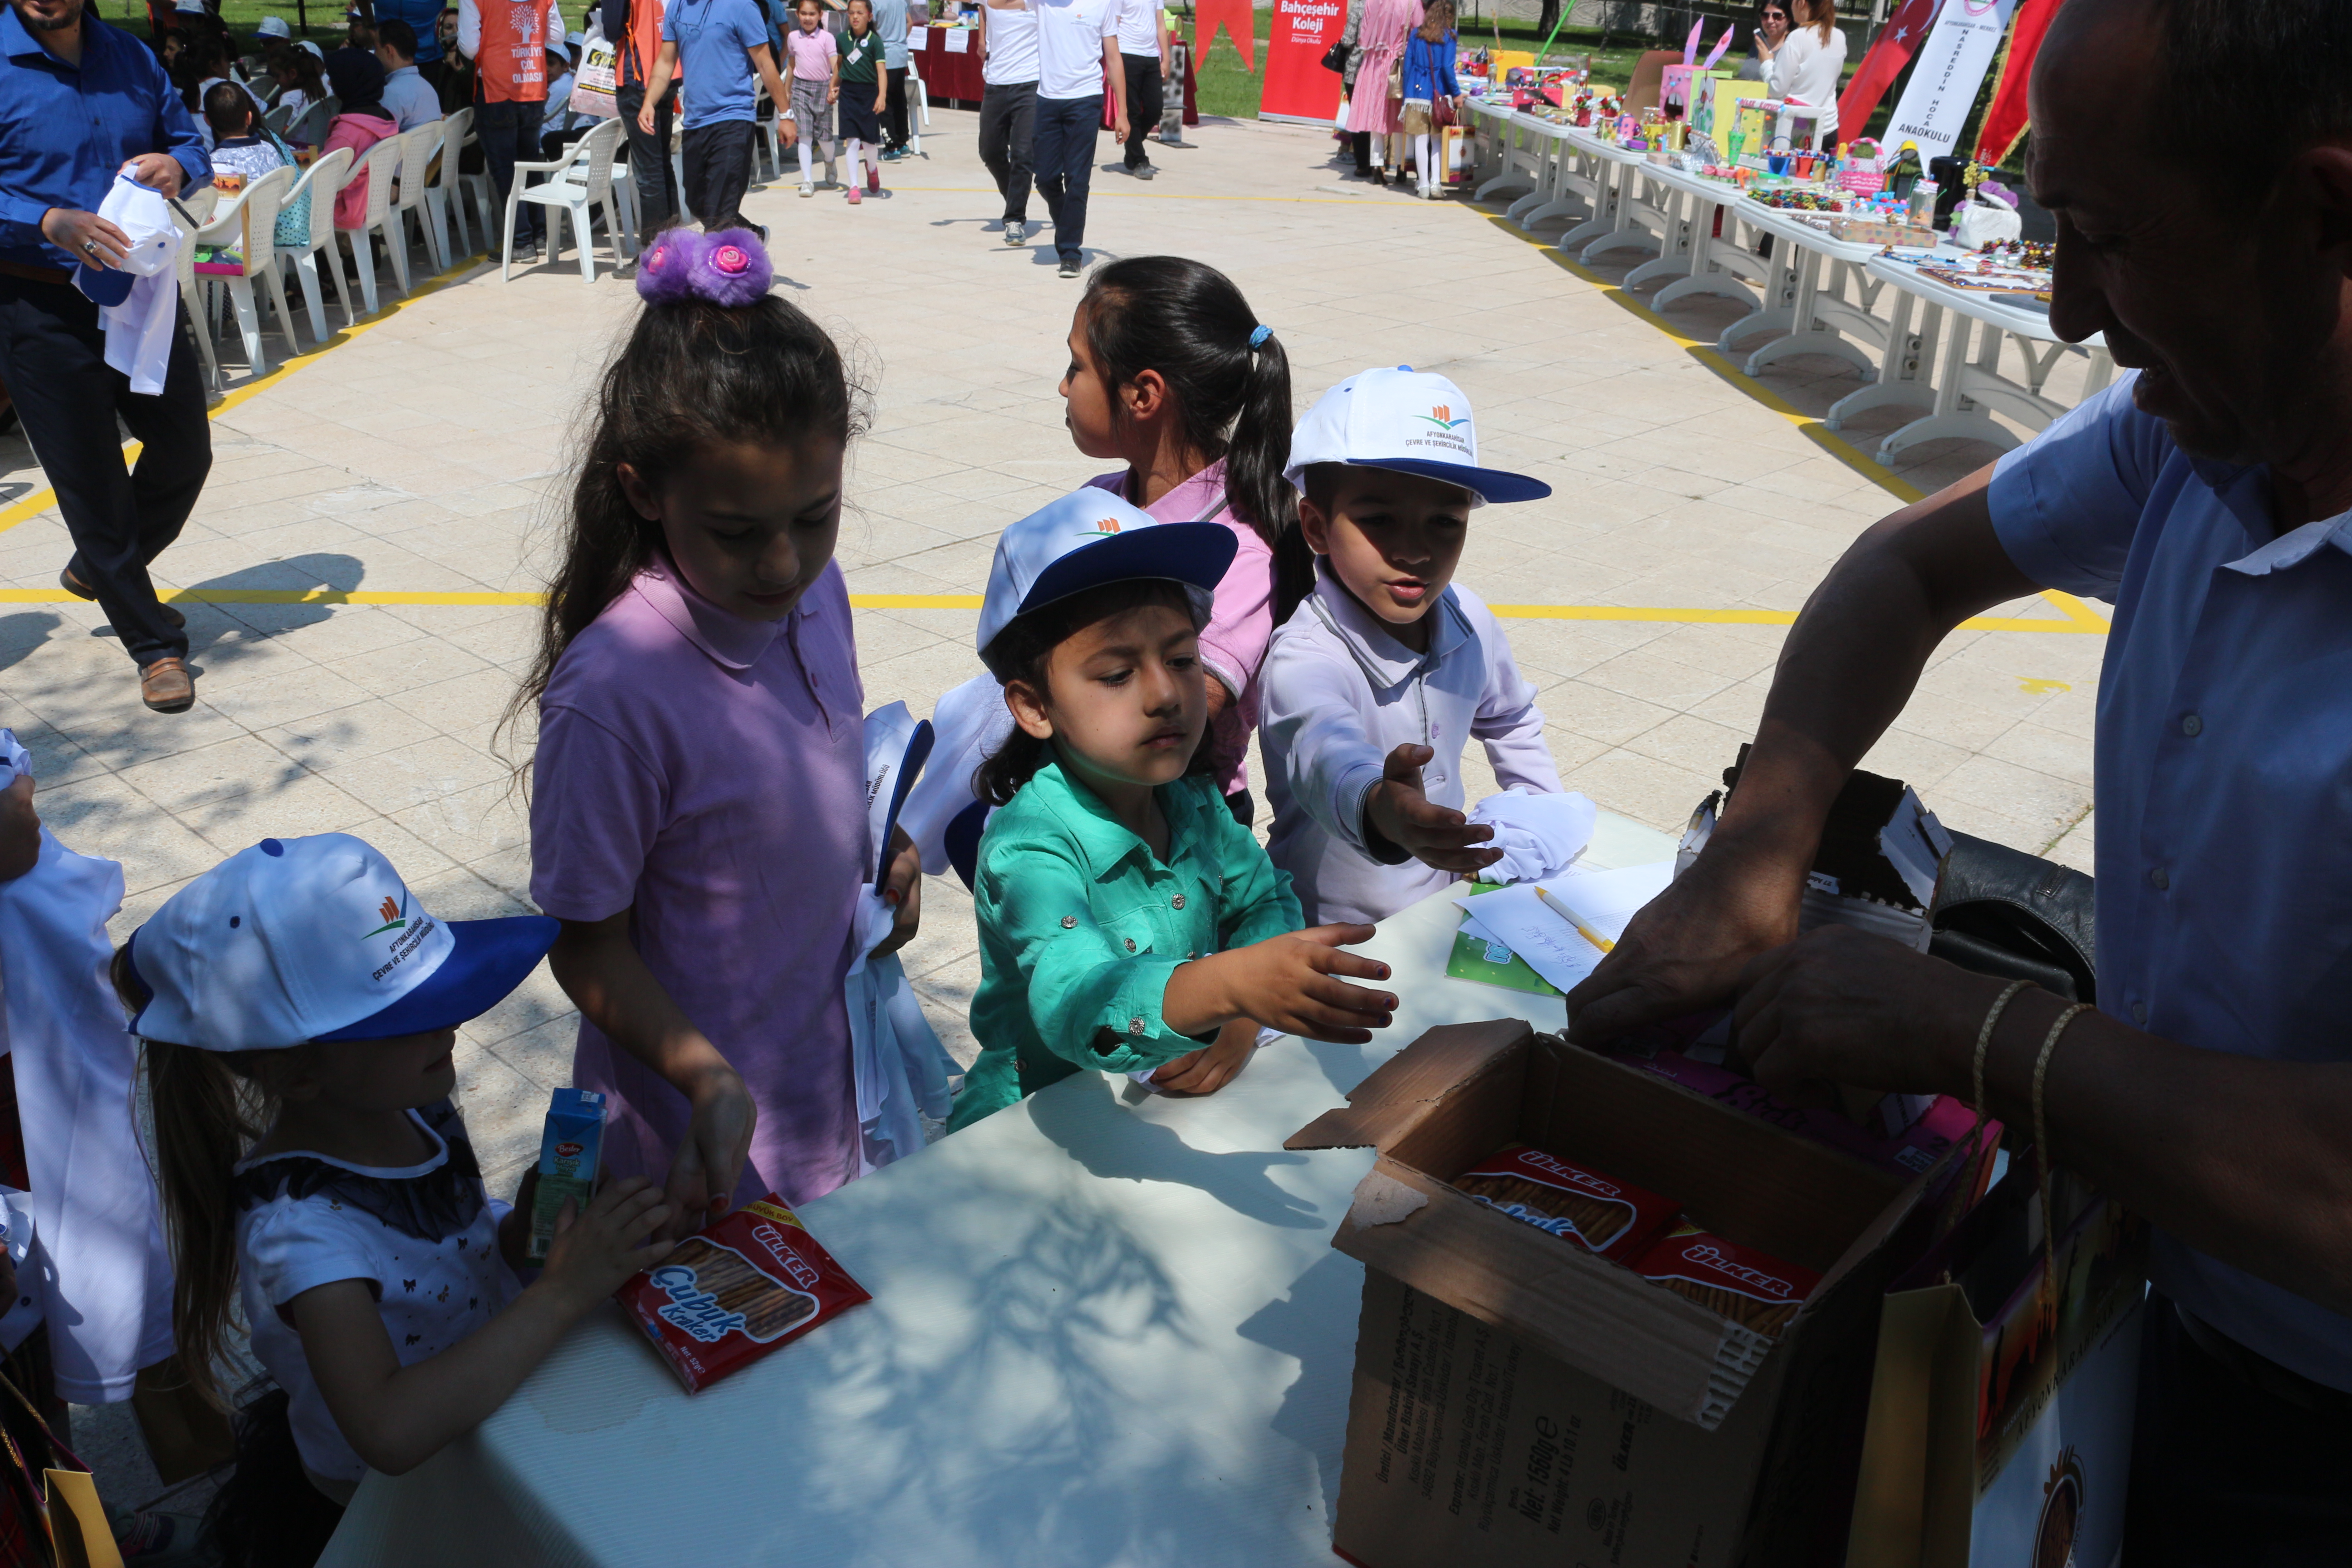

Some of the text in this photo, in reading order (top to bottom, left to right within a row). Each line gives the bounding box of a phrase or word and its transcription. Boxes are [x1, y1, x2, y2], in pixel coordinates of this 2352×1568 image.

[1280, 0, 1339, 17] Bahçeşehir
[1293, 17, 1323, 34] Koleji
[511, 44, 543, 58] TÜRKİYE
[520, 58, 536, 73] ÇÖL
[1898, 123, 1951, 142] ANAOKULU
[1923, 99, 1939, 126] HOCA
[1406, 439, 1423, 447] ÇEVRE
[1432, 440, 1457, 450] ŞEHİRCİLİK
[871, 764, 890, 794] MÜDÜRLÜĞÜ
[389, 916, 423, 953] AFYONKARAHİSAR
[372, 961, 394, 982] ÇEVRE
[392, 955, 401, 965] VE
[400, 935, 422, 960] ŞEHİRCİLİK
[554, 1156, 580, 1166] Karışık
[1518, 1151, 1621, 1197] ÜLKER
[747, 1202, 794, 1222] BÜYÜK BOY
[752, 1225, 819, 1289] ÜLKER
[1681, 1244, 1793, 1298] ÜLKER
[653, 1267, 744, 1333] Çubuk
[662, 1306, 716, 1339] Kraker
[1443, 1308, 1459, 1351] İstanbul
[680, 1346, 692, 1359] Net:
[1382, 1379, 1402, 1445] Manufacturer
[1394, 1330, 1426, 1455] Ülker Bisküvi Sanayi A.Ş.
[1408, 1309, 1442, 1484] Kısıklı Mahallesi Ferah Caddesi No:1
[1426, 1361, 1452, 1469] Büyükçamlıca-Üsküdar
[1448, 1327, 1491, 1515] Exporter: İstanbul Gıda Dış Ticaret A.Ş.
[1467, 1362, 1499, 1500] Kısıklı Mah. Ferah Cad. No:1
[1526, 1437, 1559, 1486] 1560g
[1612, 1421, 1635, 1471] ÜLKER
[1375, 1450, 1392, 1483] Üretici
[1421, 1468, 1436, 1500] 34692
[1478, 1465, 1499, 1532] Büyükçamlıca
[1490, 1424, 1506, 1465] Üsküdar
[1548, 1415, 1581, 1534] Net Weight: 4 Lb 10.1 oz
[1519, 1488, 1546, 1524] Net:
